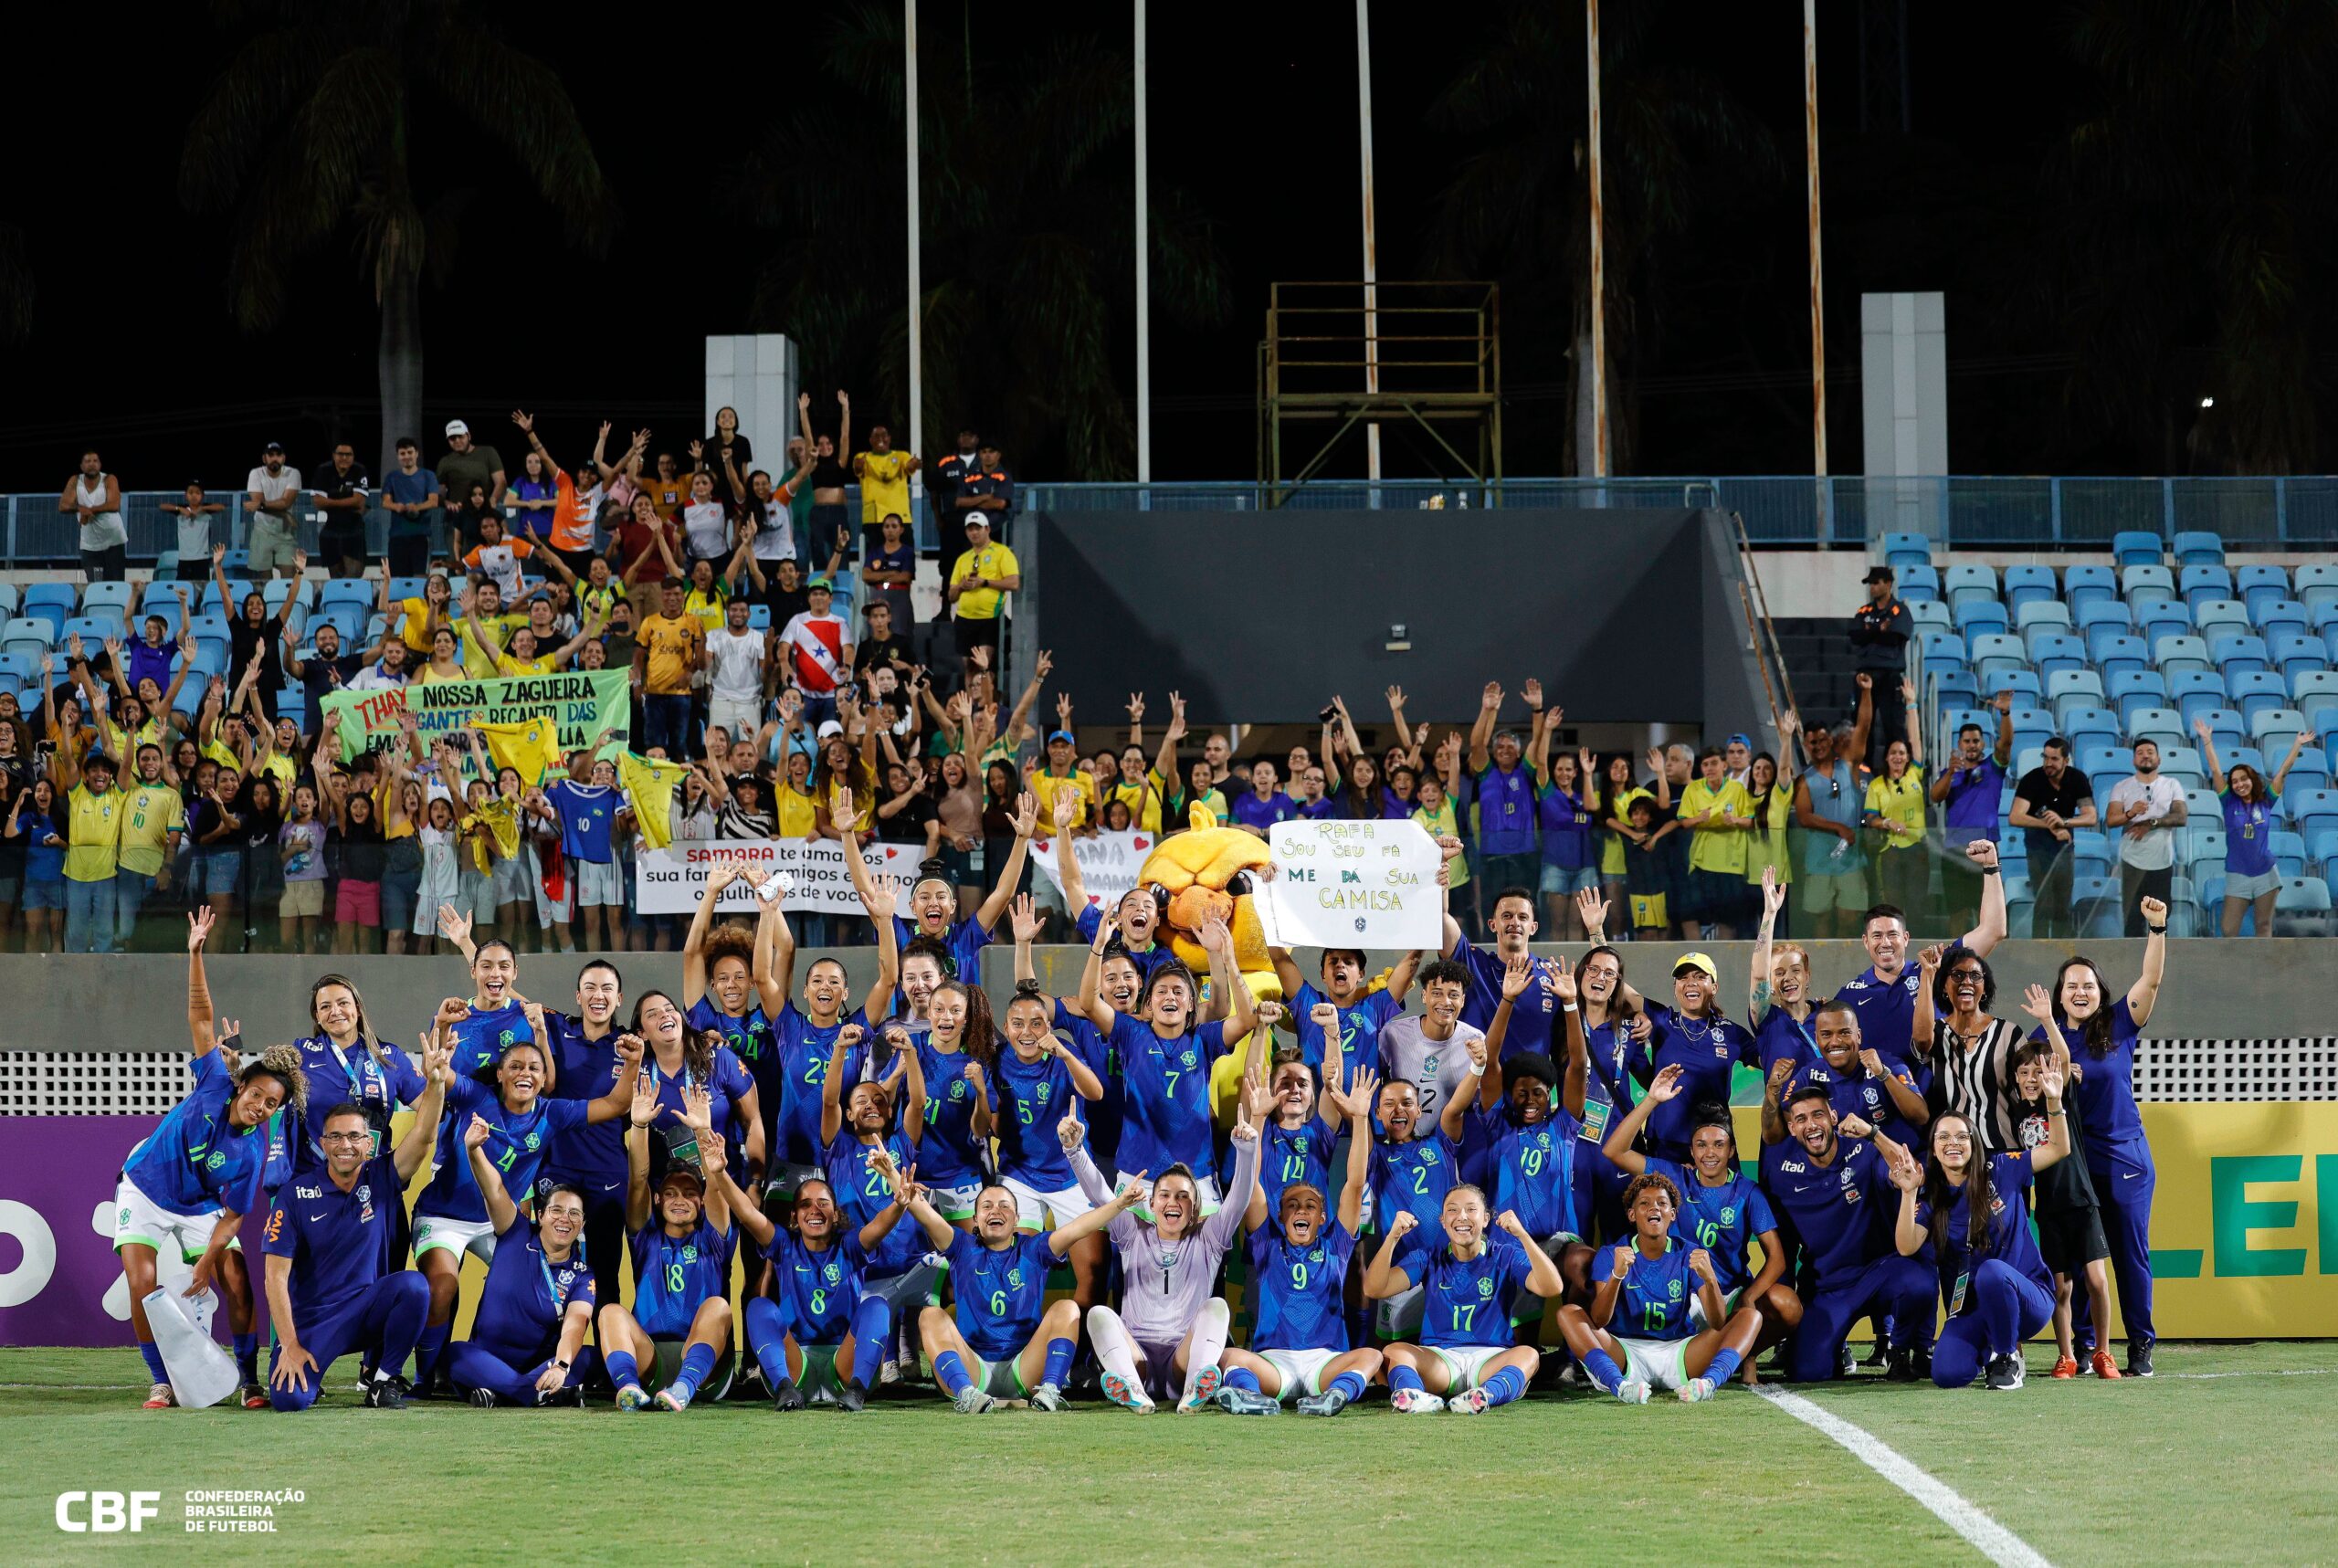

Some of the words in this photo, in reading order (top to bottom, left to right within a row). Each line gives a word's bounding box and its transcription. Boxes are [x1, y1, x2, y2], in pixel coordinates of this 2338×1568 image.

[353, 688, 407, 729] THAY
[423, 686, 488, 709] NOSSA
[500, 676, 596, 704] ZAGUEIRA
[567, 702, 597, 722] DAS
[132, 812, 145, 829] 10
[576, 817, 591, 833] 10
[1313, 823, 1374, 845] RAFA
[687, 847, 774, 862] SAMARA
[780, 847, 797, 860] te
[802, 848, 883, 866] amaos
[1280, 837, 1316, 859] SOU
[1332, 844, 1364, 858] SEU
[646, 870, 679, 882] sua
[1288, 868, 1316, 882] ME
[1342, 868, 1361, 883] DÁ
[1385, 868, 1419, 885] SUA
[801, 885, 821, 900] de
[826, 889, 863, 903] voc
[1318, 887, 1403, 910] CAMISA
[302, 1039, 324, 1052] itaú
[728, 1034, 758, 1061] 24
[1165, 1070, 1180, 1099] 7
[1017, 1099, 1034, 1124] 5
[497, 1145, 518, 1173] 4
[1281, 1154, 1306, 1183] 14
[1520, 1146, 1543, 1176] 19
[1781, 1160, 1806, 1173] itaú
[295, 1185, 323, 1199] itaú
[1412, 1166, 1429, 1194] 2
[269, 1208, 285, 1243] vivo
[1695, 1218, 1720, 1248] 16
[665, 1263, 686, 1293] 18
[1163, 1268, 1169, 1295] 1
[1291, 1262, 1308, 1290] 9
[810, 1288, 827, 1315] 8
[990, 1289, 1006, 1317] 6
[1452, 1304, 1477, 1331] 17
[1643, 1300, 1668, 1331] 15
